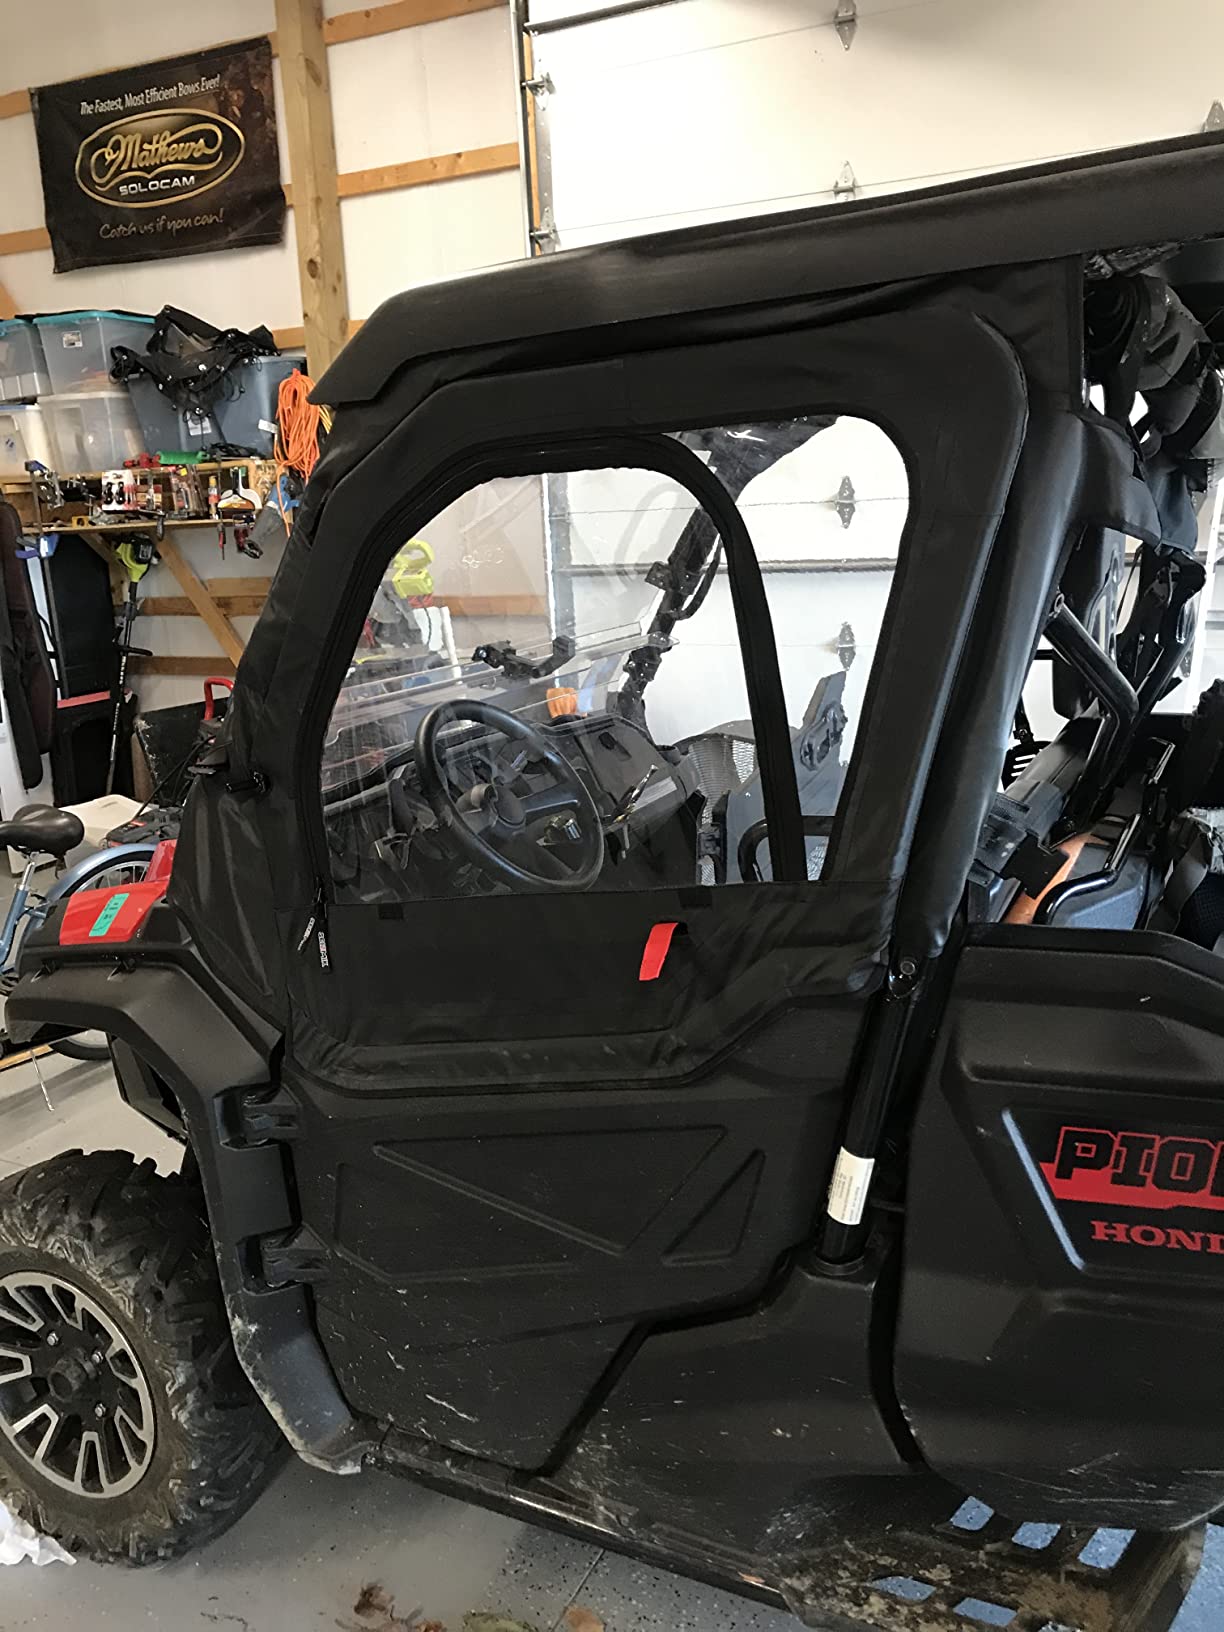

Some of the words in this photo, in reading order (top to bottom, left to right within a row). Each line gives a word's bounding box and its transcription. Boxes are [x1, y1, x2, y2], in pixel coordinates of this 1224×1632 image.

[80, 101, 94, 115] The
[94, 97, 124, 114] Fastest,
[124, 92, 145, 108] Most
[145, 85, 177, 104] Efficient
[177, 82, 200, 97] Bows
[200, 73, 220, 91] Ever!
[90, 122, 223, 184] Mathews
[118, 175, 195, 196] SOLOCAM
[99, 222, 137, 239] Catch
[139, 223, 154, 234] us
[156, 215, 167, 232] if
[167, 217, 192, 236] you
[193, 207, 224, 226] can!
